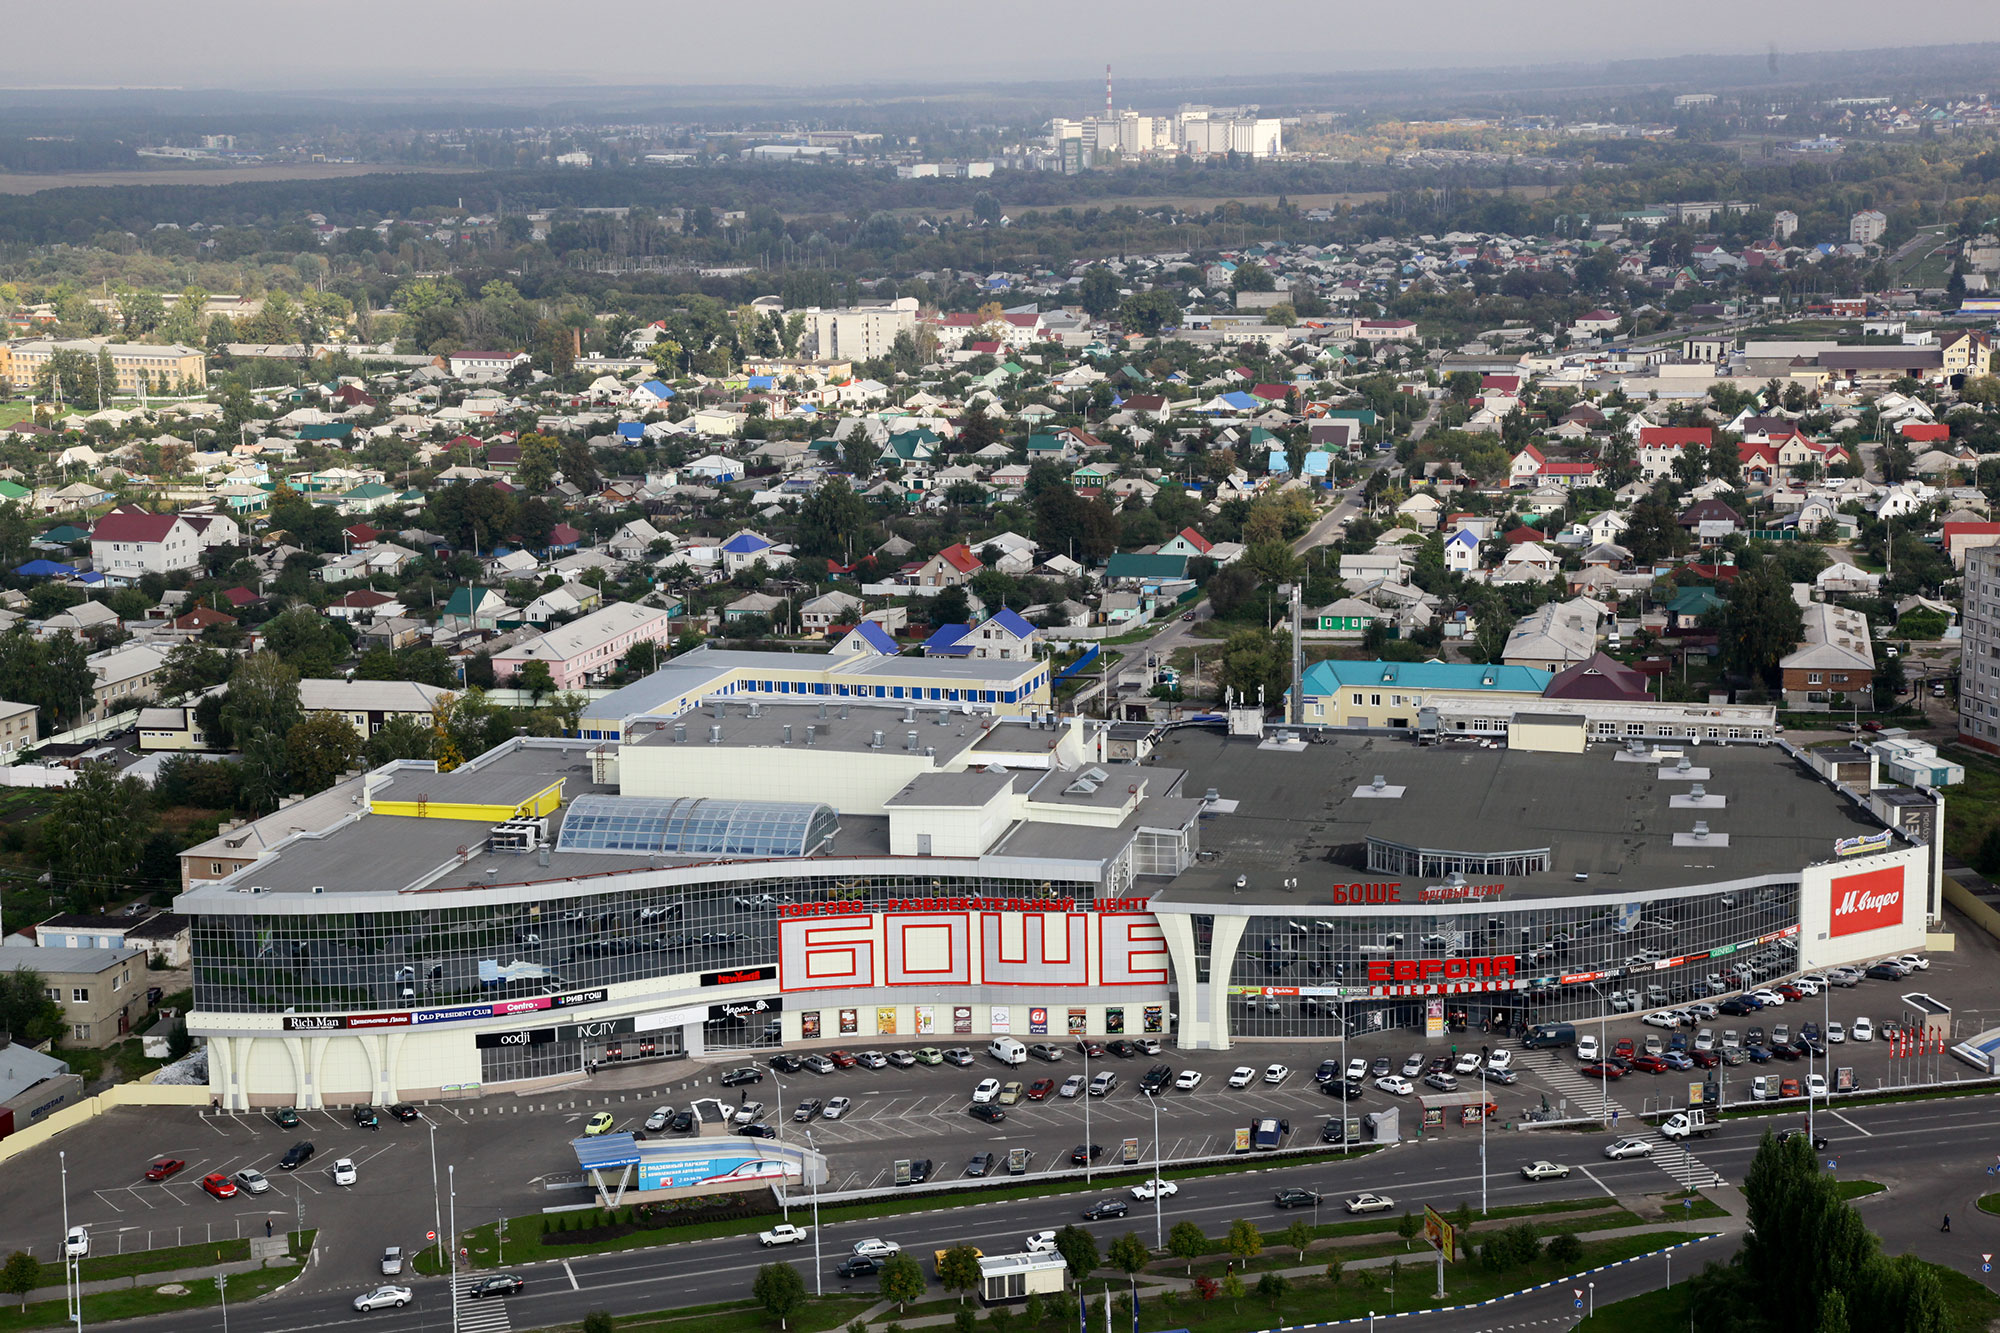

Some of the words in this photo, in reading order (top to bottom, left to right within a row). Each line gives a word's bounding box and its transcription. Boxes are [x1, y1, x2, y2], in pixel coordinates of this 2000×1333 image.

[1333, 883, 1400, 904] БОШЕ
[1418, 885, 1469, 901] ТОРГОВЫЙ
[1473, 884, 1505, 898] ЦЕНТР
[777, 900, 864, 917] ТОРГОВО
[887, 896, 1075, 912] РАЗВЛЕКАТЕЛЬНЫЙ
[778, 911, 1168, 992] БОШЕ
[1368, 955, 1516, 981] ЕВРОПА
[1629, 964, 1652, 974] Valentino
[1369, 980, 1516, 997] ГИПЕРМАРКЕТ
[566, 995, 583, 1004] РИВ
[584, 991, 602, 1001] ГОШ
[506, 1002, 534, 1012] Centro
[291, 1017, 314, 1027] Rich
[316, 1016, 339, 1027] Man
[658, 1013, 686, 1025] DESEO
[1032, 1011, 1044, 1021] GJ
[577, 1021, 617, 1038] INCITY
[500, 1032, 531, 1045] oodji
[31, 1094, 65, 1118] GENSTAR
